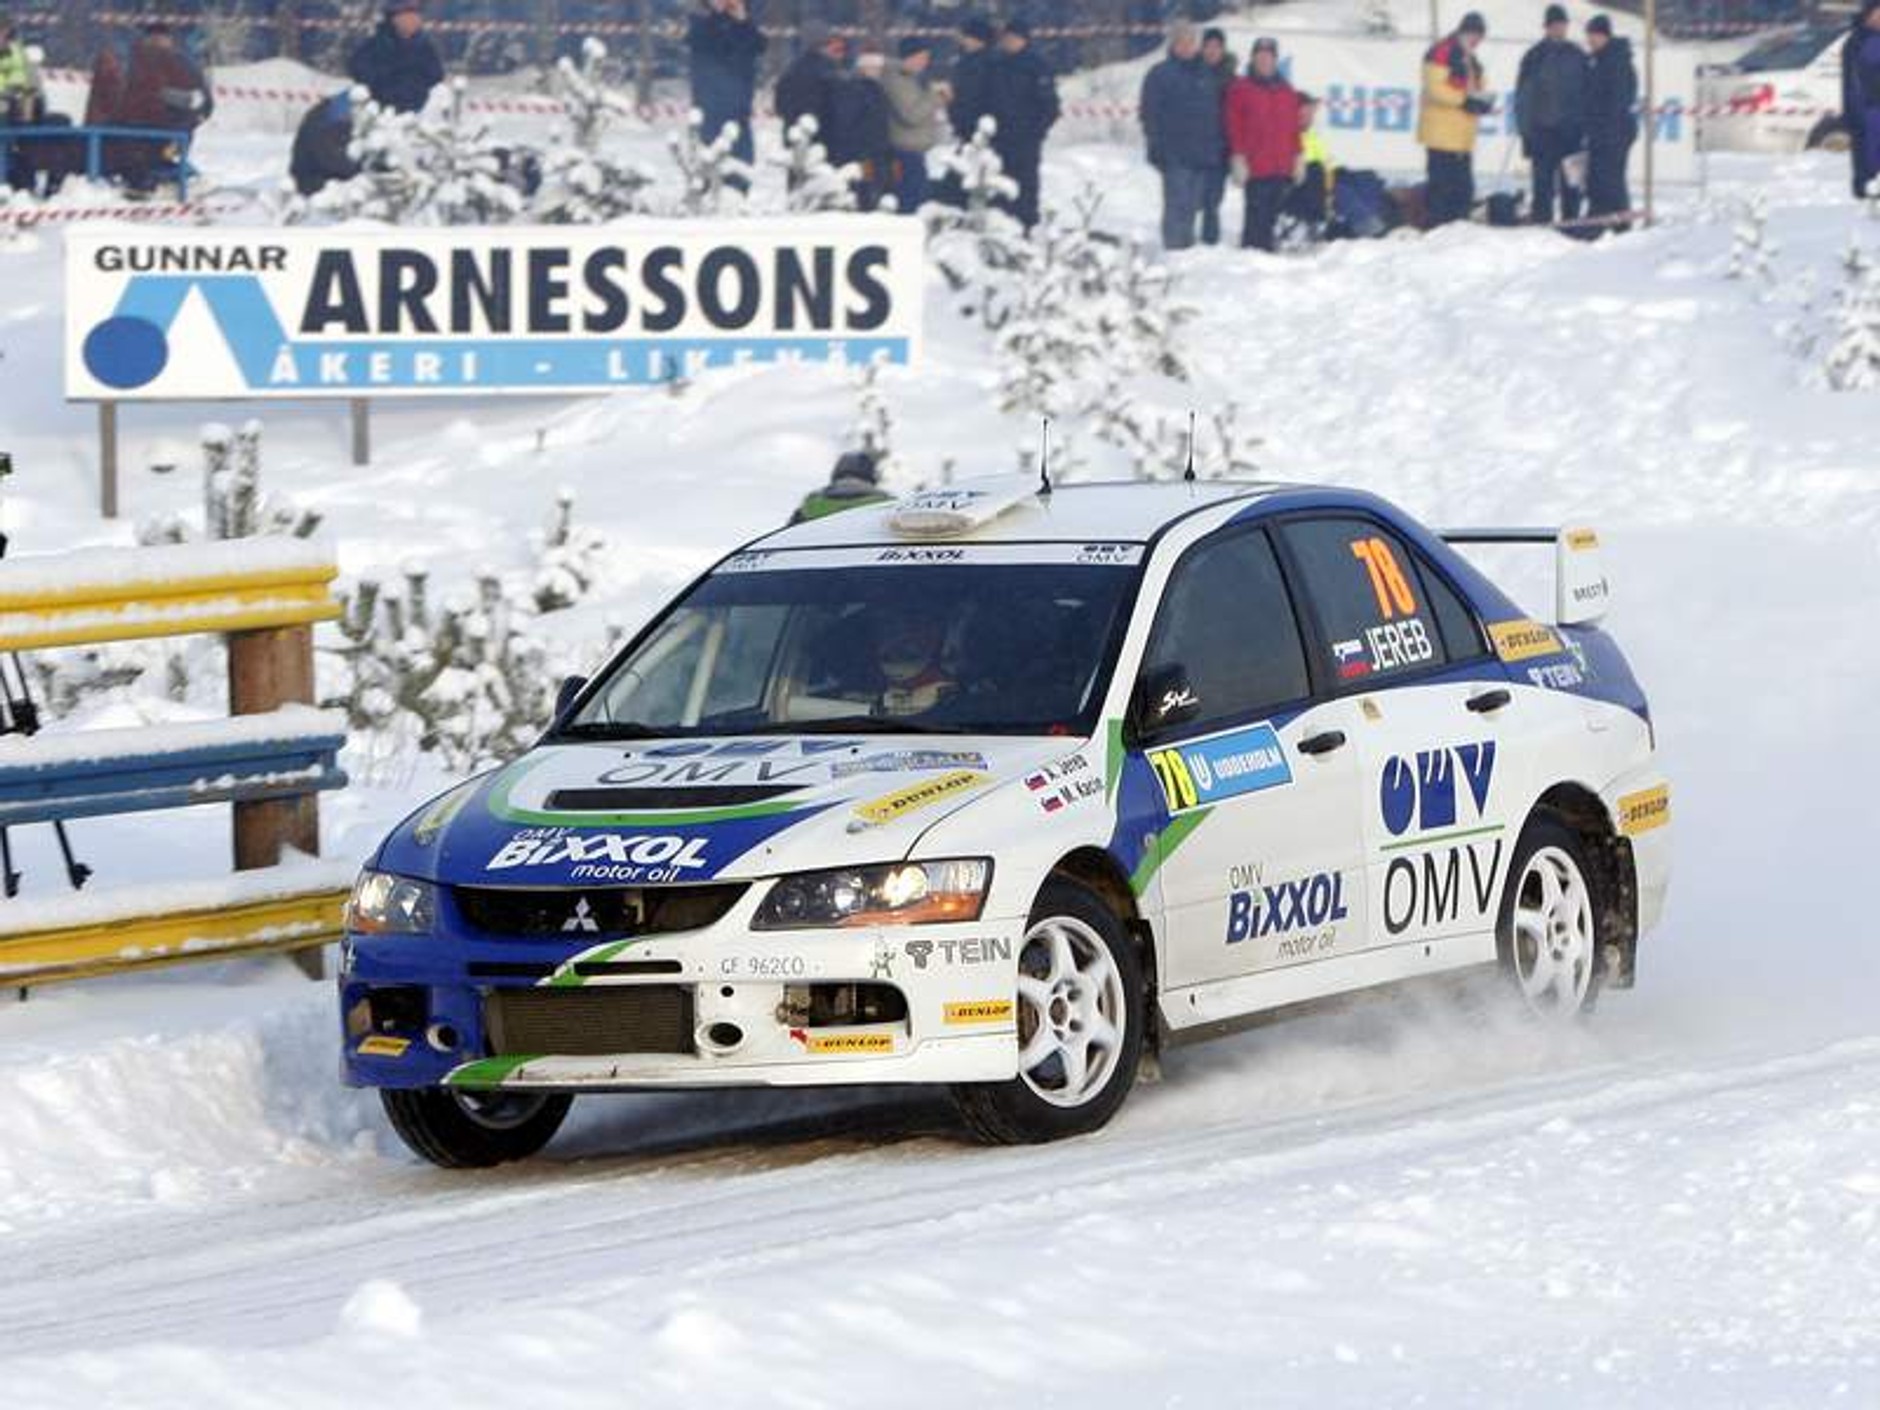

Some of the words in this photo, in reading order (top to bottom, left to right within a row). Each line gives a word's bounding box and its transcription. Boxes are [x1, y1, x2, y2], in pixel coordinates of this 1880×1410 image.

[95, 246, 288, 271] GUNNAR
[299, 246, 894, 333] ARNESSONS
[269, 343, 479, 384] ÅKERI
[1351, 538, 1417, 618] 78
[1366, 619, 1433, 672] JEREB
[597, 762, 820, 785] OMV
[1151, 750, 1198, 810] 78
[513, 828, 573, 841] OMV
[486, 833, 711, 871] BiXXOL
[570, 865, 645, 880] motor
[648, 866, 680, 882] oil
[1228, 864, 1264, 887] OMV
[1384, 839, 1503, 935] OMV
[1226, 871, 1348, 943] BiXXOL
[938, 937, 1012, 964] TEIN
[1278, 935, 1318, 958] motor
[1318, 930, 1336, 948] oil
[824, 1037, 890, 1048] DUNLOP
